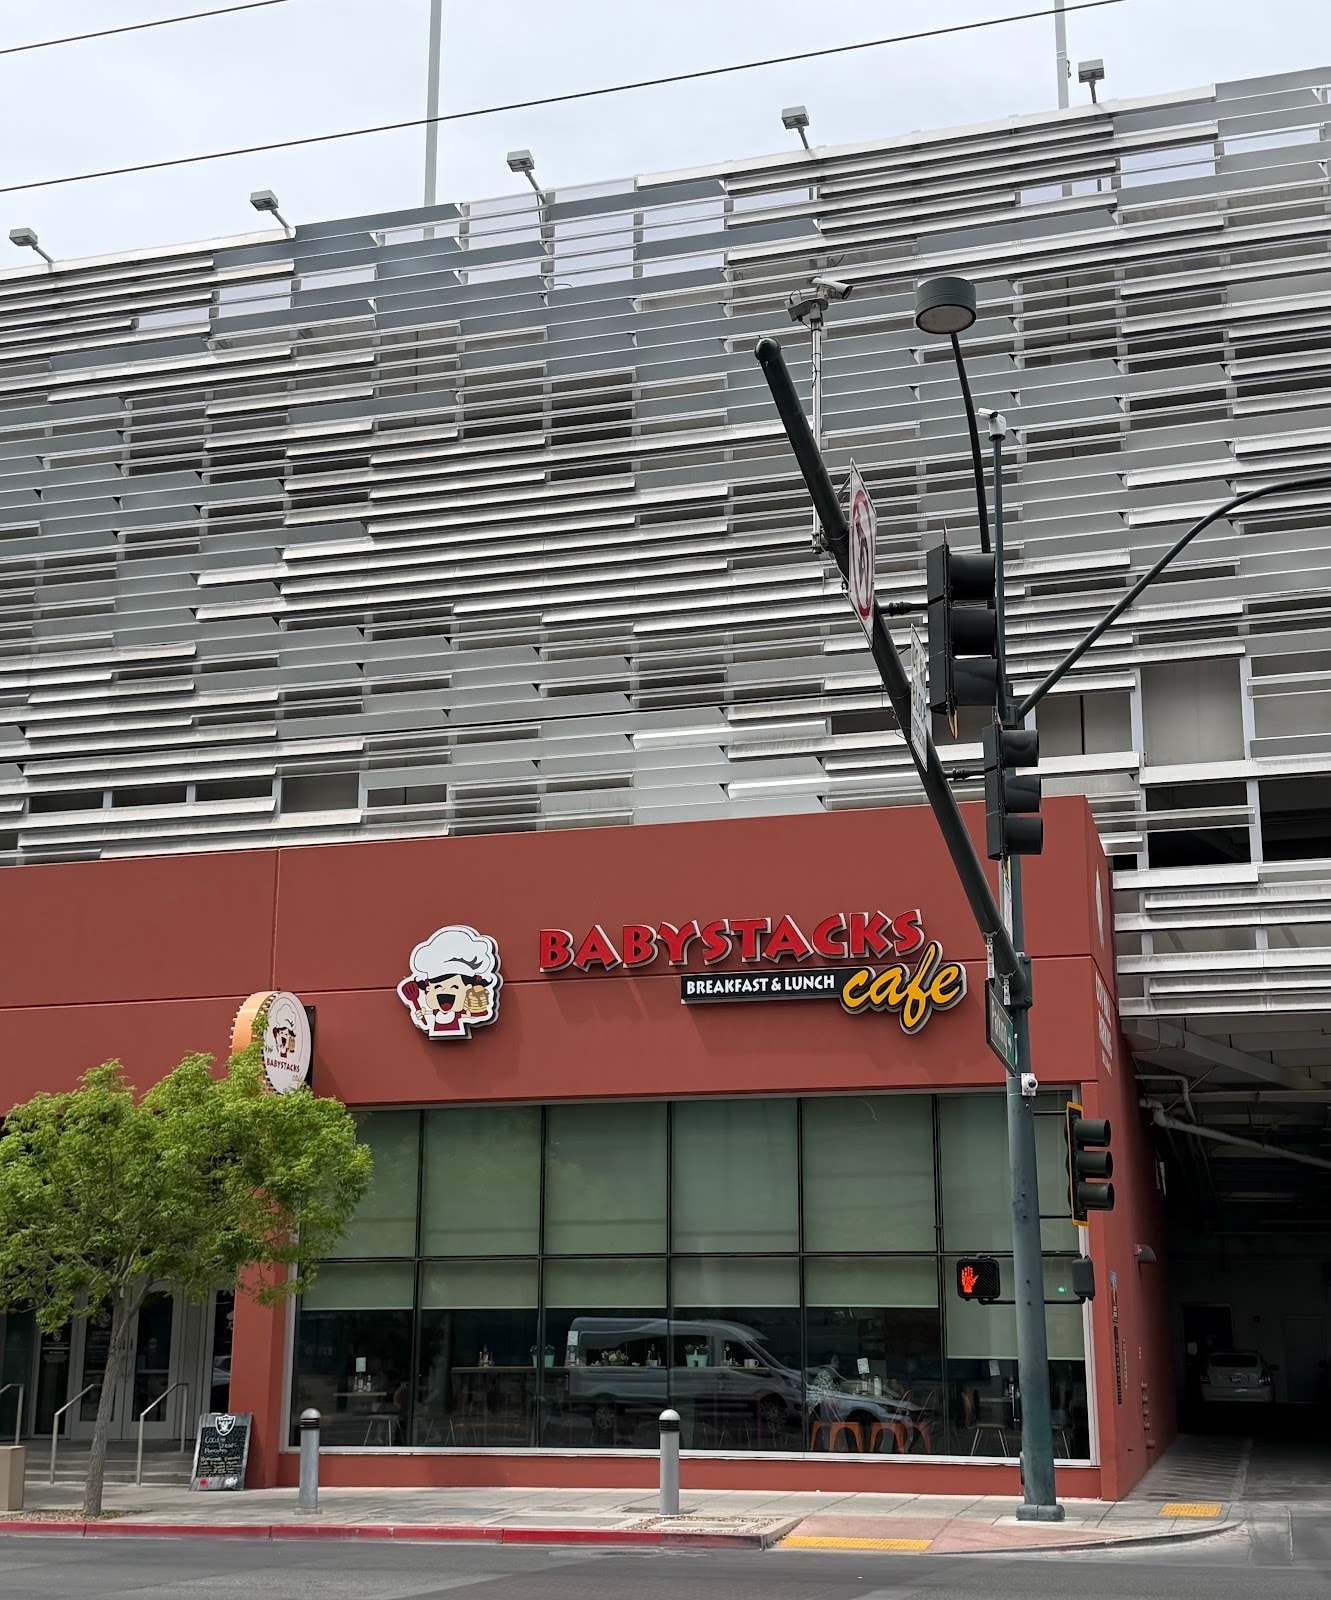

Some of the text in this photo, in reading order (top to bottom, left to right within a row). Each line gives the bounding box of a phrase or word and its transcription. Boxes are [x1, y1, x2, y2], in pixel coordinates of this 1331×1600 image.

[540, 909, 924, 972] BABYSTACKS
[686, 975, 834, 995] BREAKFAST & LUNCH
[842, 943, 961, 1028] cafe
[266, 1057, 300, 1073] BABYSTACKS
